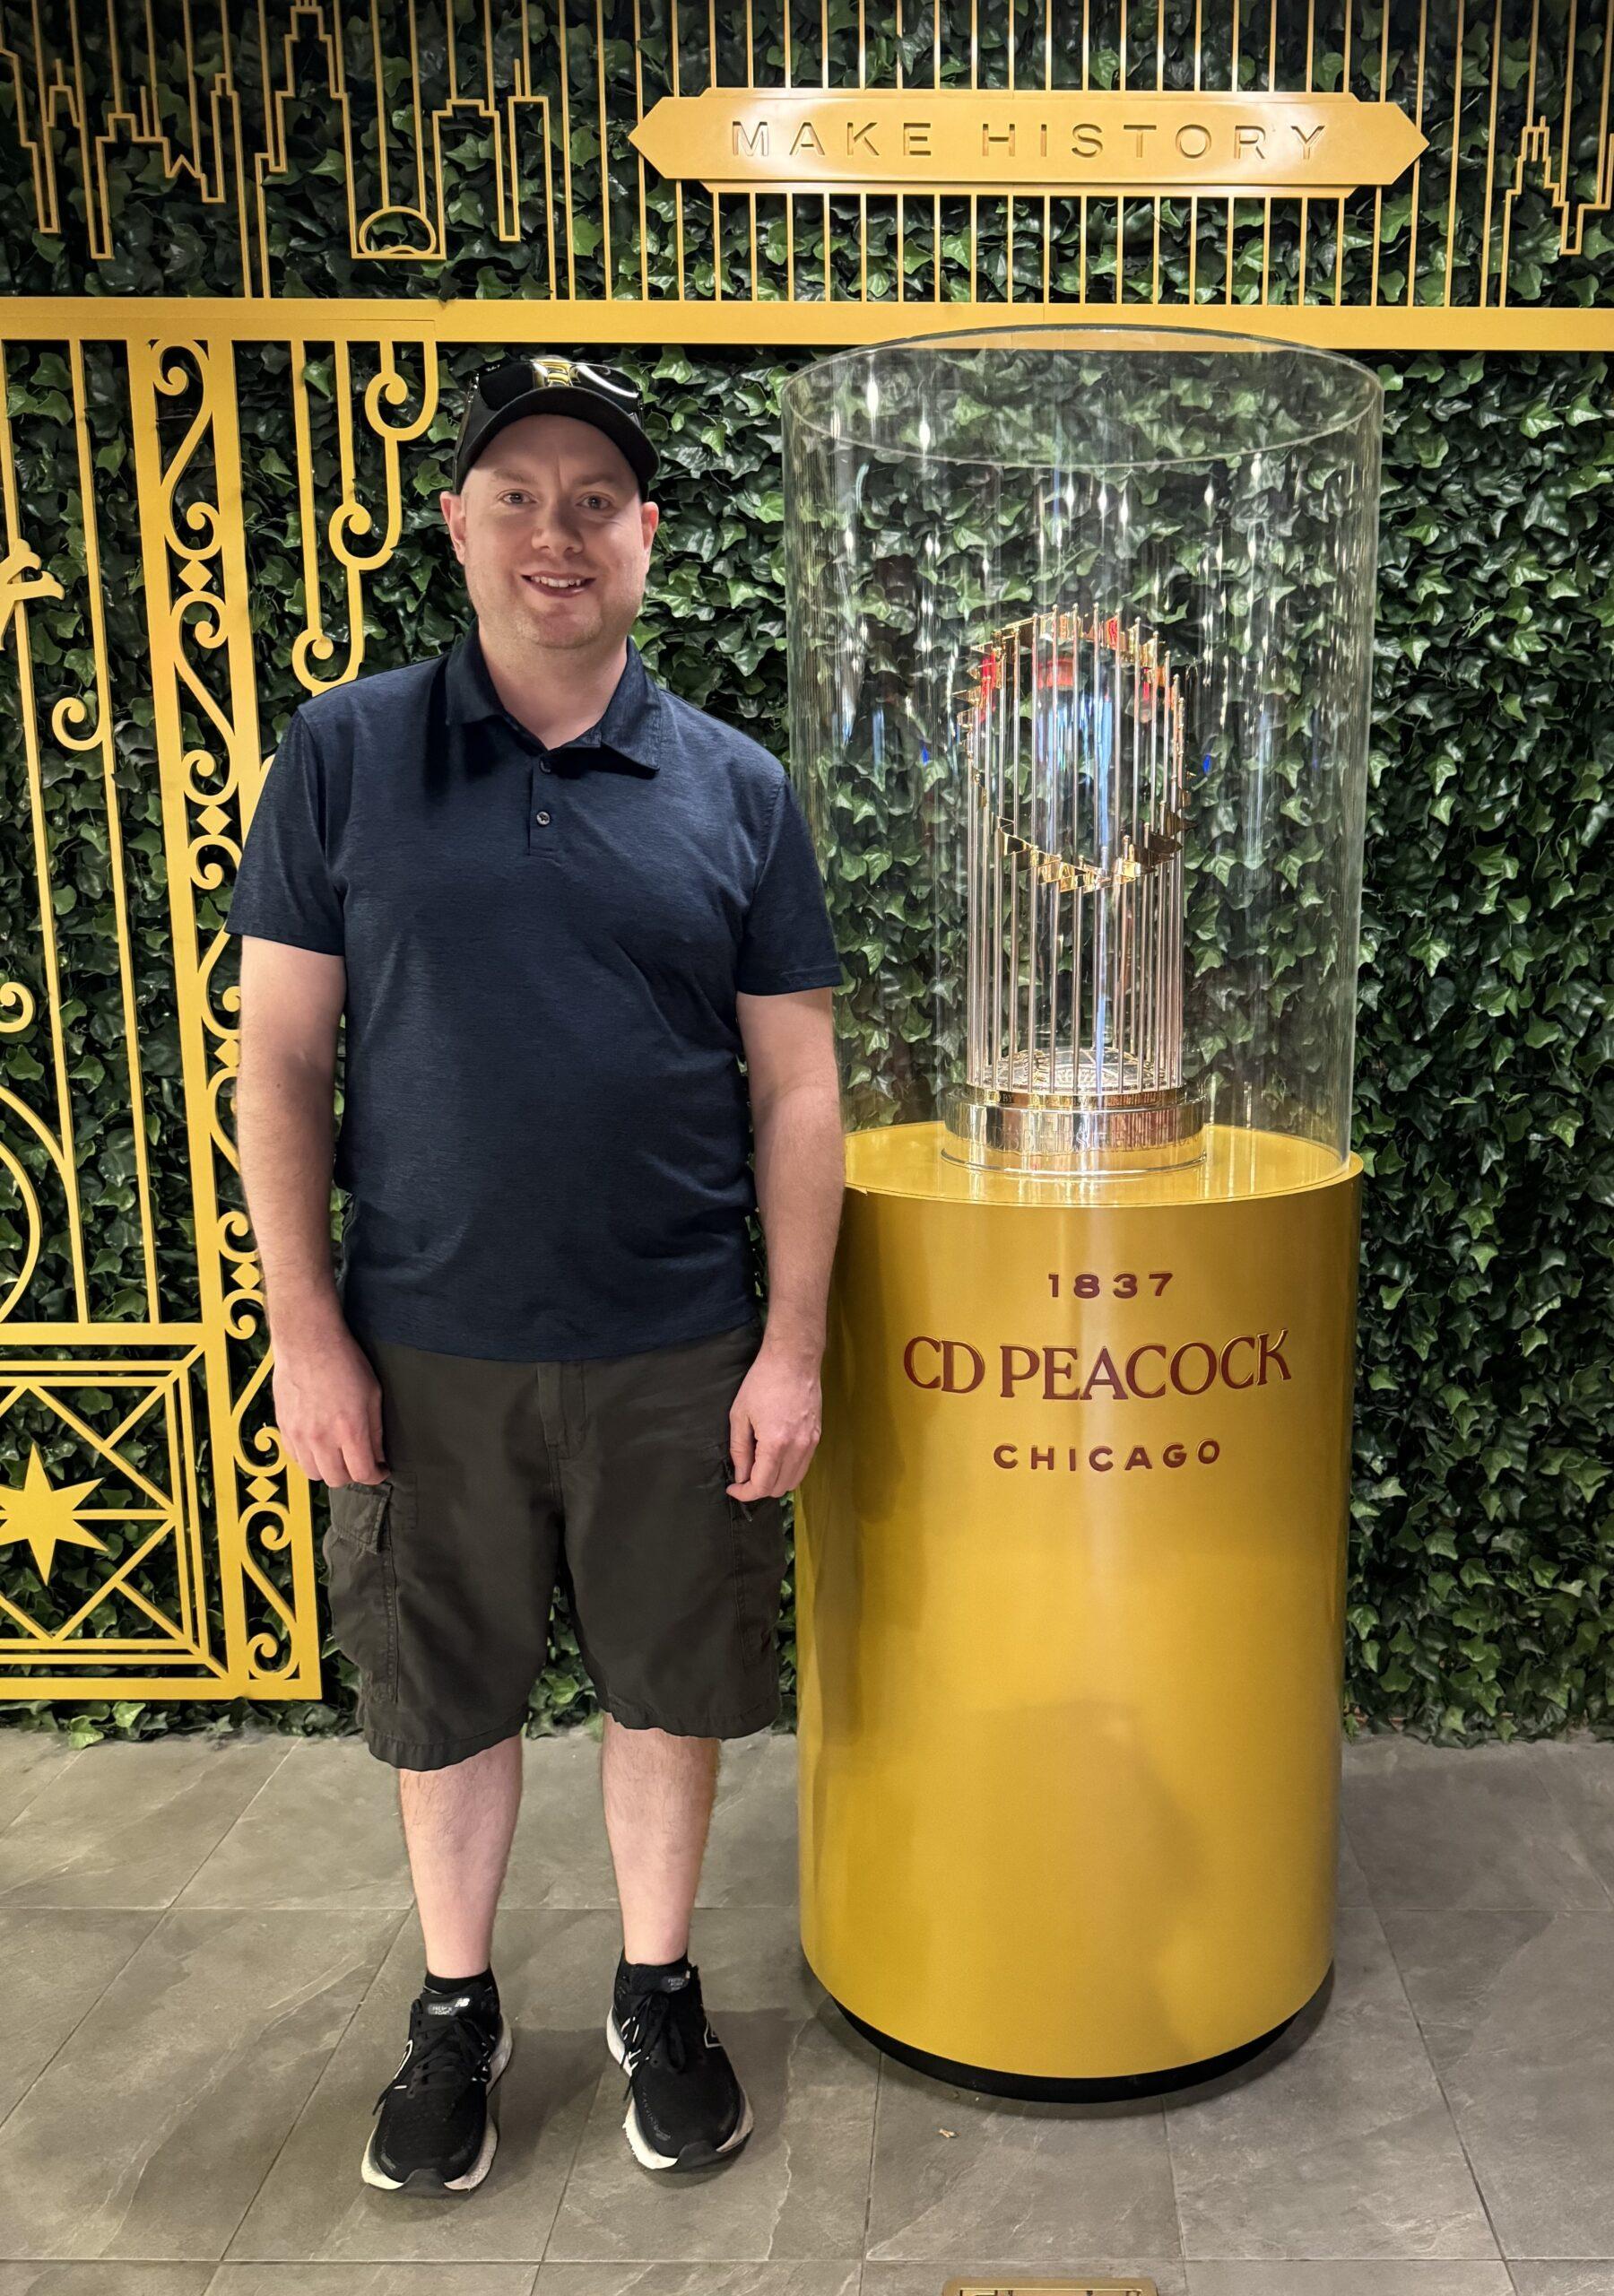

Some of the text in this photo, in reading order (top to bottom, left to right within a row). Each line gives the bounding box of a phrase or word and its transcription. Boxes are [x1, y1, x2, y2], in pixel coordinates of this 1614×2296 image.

[731, 120, 1327, 160] MAKE HISTORY
[1047, 1271, 1174, 1300] 1837
[903, 1327, 1292, 1401] CD PEACOCK
[993, 1438, 1220, 1473] CHICAGO
